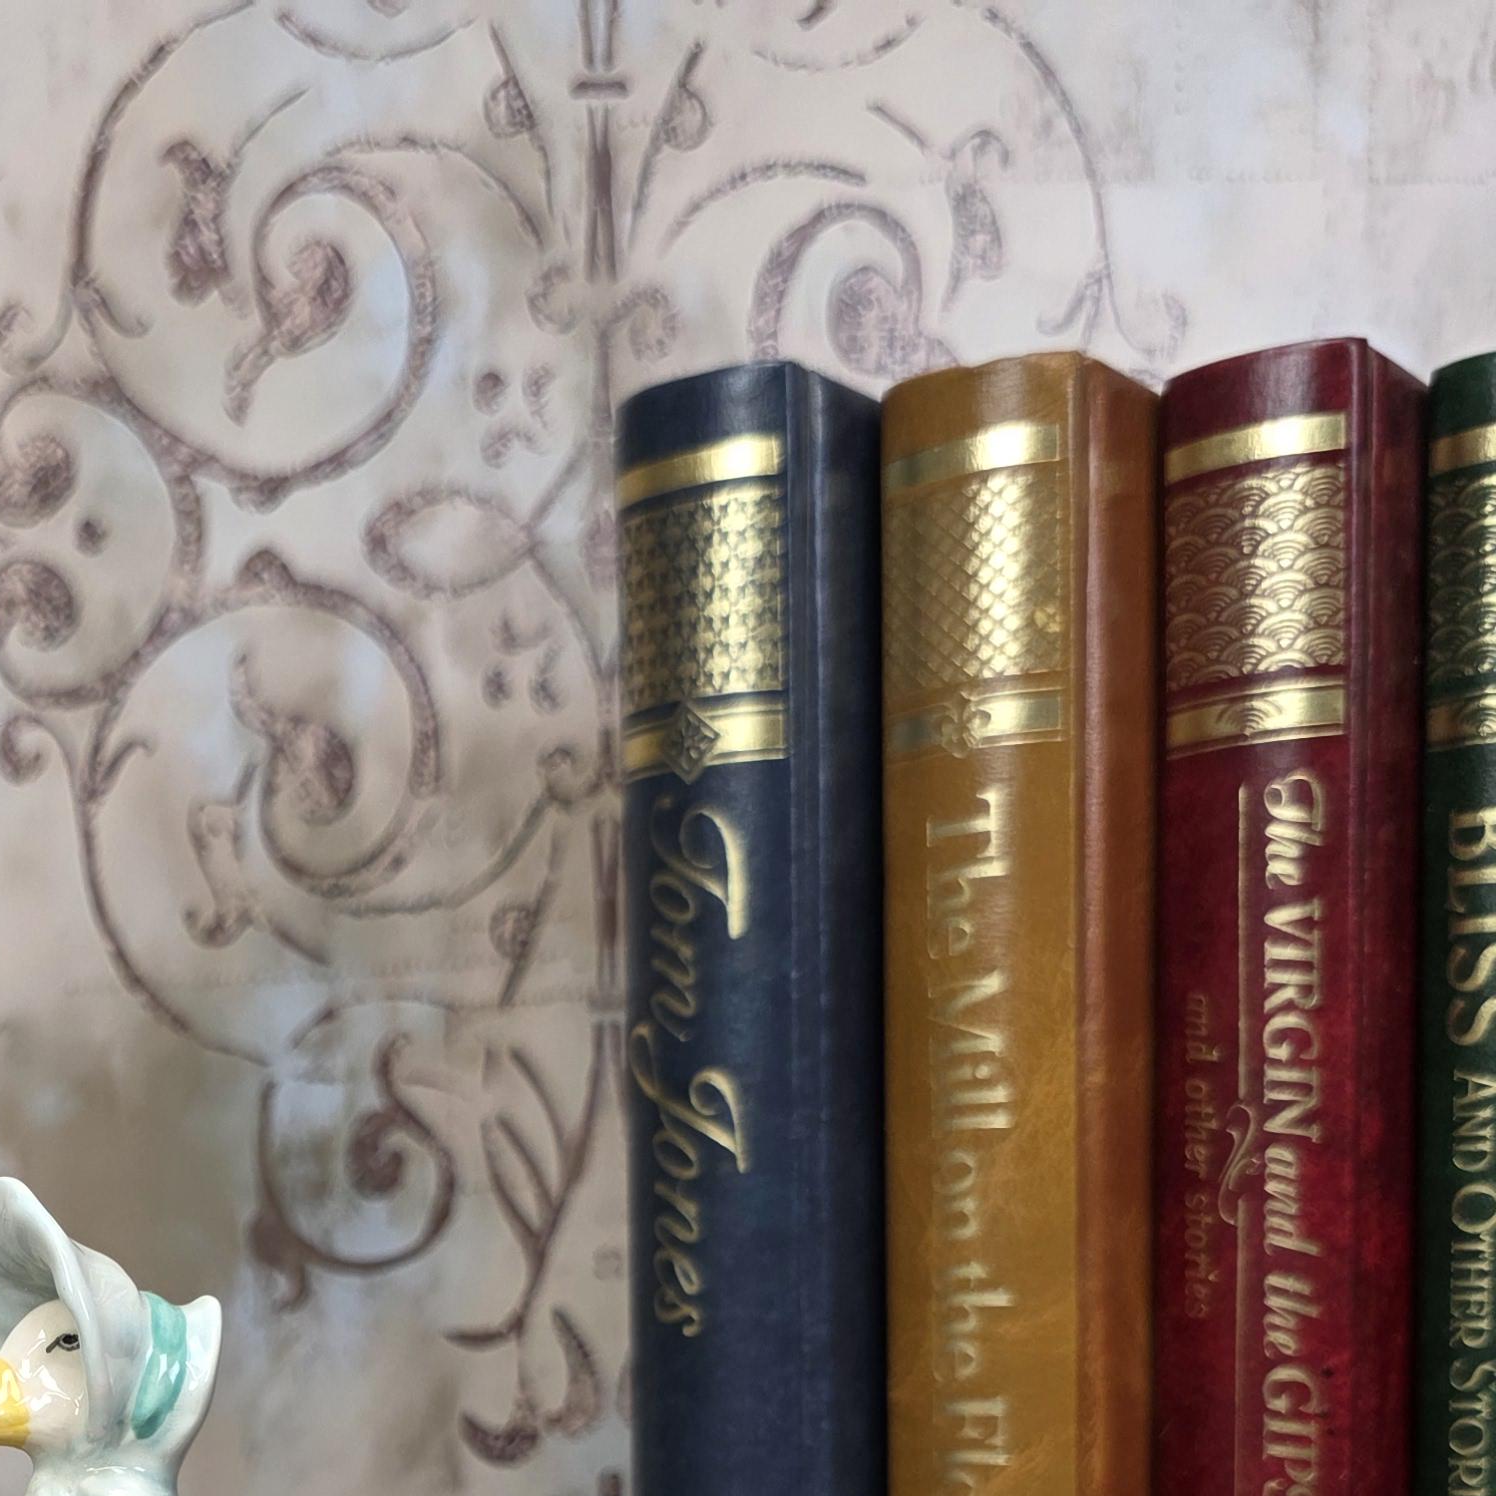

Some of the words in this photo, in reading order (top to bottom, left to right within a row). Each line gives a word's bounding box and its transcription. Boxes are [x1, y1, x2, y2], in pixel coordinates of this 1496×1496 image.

[926, 785, 1011, 960] The
[1263, 767, 1324, 890] The
[650, 794, 750, 1041] Tom
[1446, 806, 1496, 1048] BLISS
[928, 966, 1015, 1138] Mill
[1184, 992, 1221, 1064] and
[1263, 896, 1324, 1143] VIRGIN
[630, 1022, 750, 1337] Jones
[1184, 1077, 1218, 1180] other
[1452, 1066, 1496, 1174] AND
[933, 1147, 980, 1246] on
[1184, 1192, 1219, 1319] stories
[1264, 1142, 1324, 1258] and
[933, 1260, 1016, 1383] the
[1264, 1271, 1324, 1359] the
[1449, 1179, 1496, 1350] OTHER
